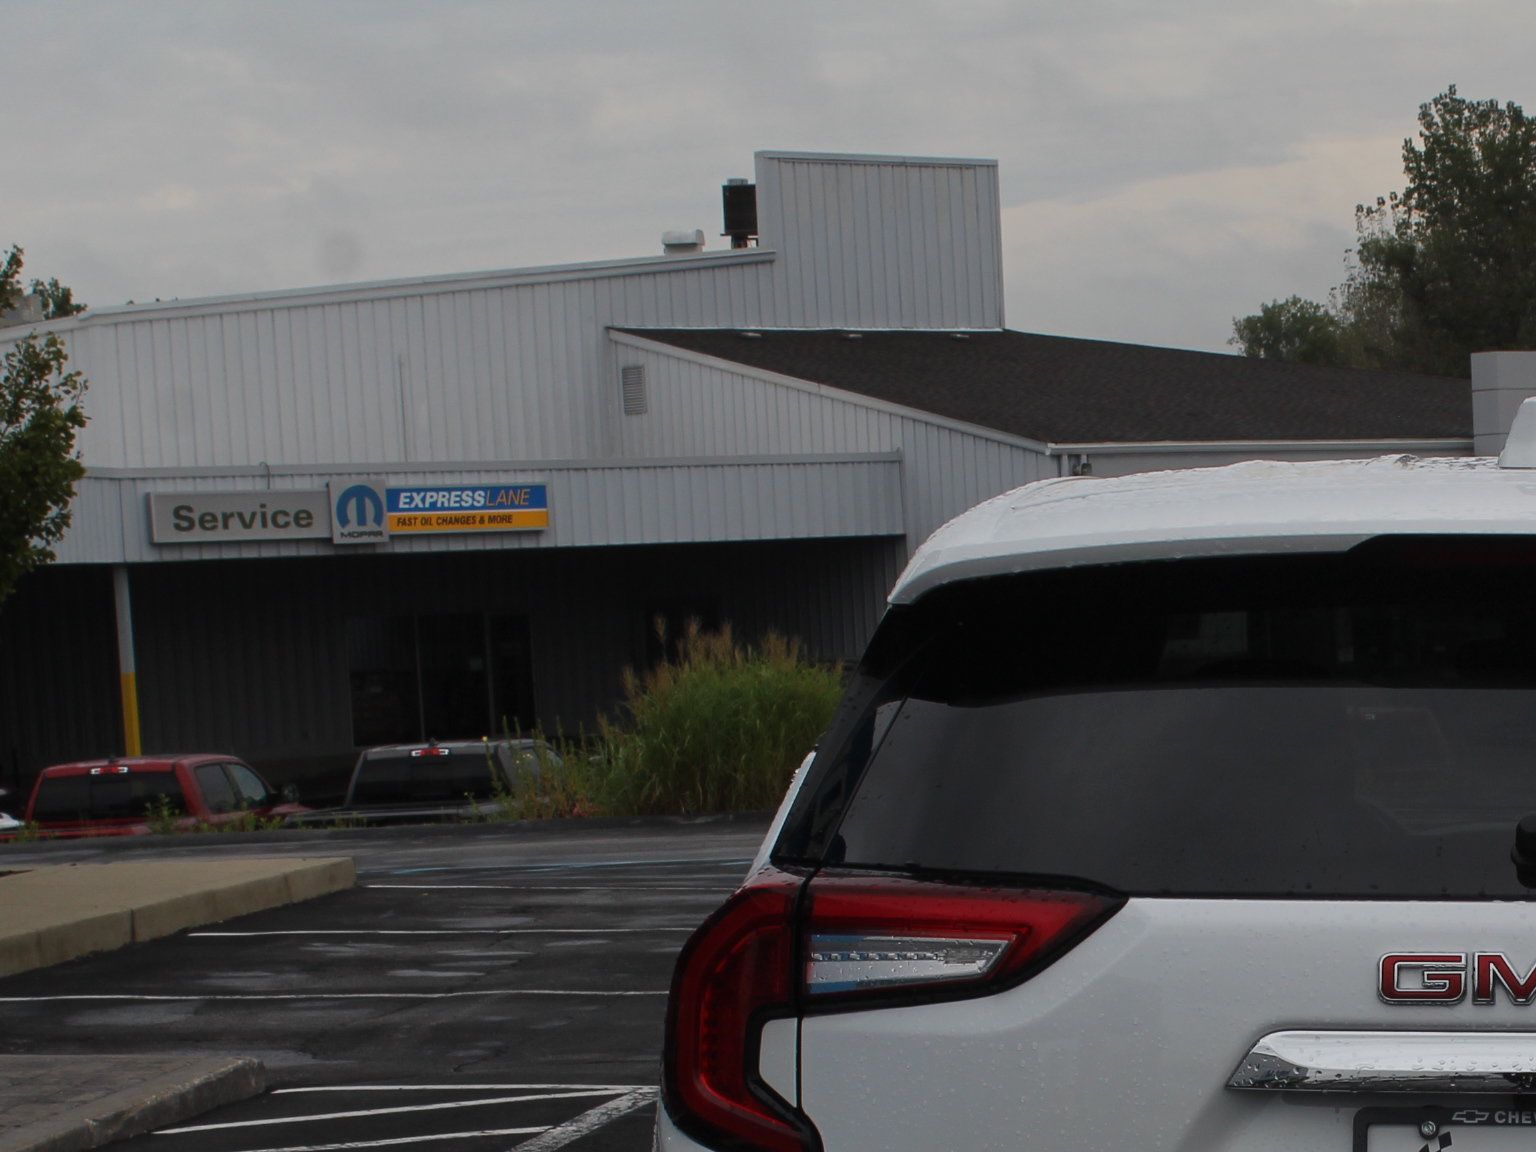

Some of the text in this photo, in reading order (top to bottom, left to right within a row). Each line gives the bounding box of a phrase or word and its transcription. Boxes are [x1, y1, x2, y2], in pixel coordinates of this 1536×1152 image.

[173, 504, 314, 533] Service
[396, 514, 513, 527] FAST OIL CHANGES & MORE
